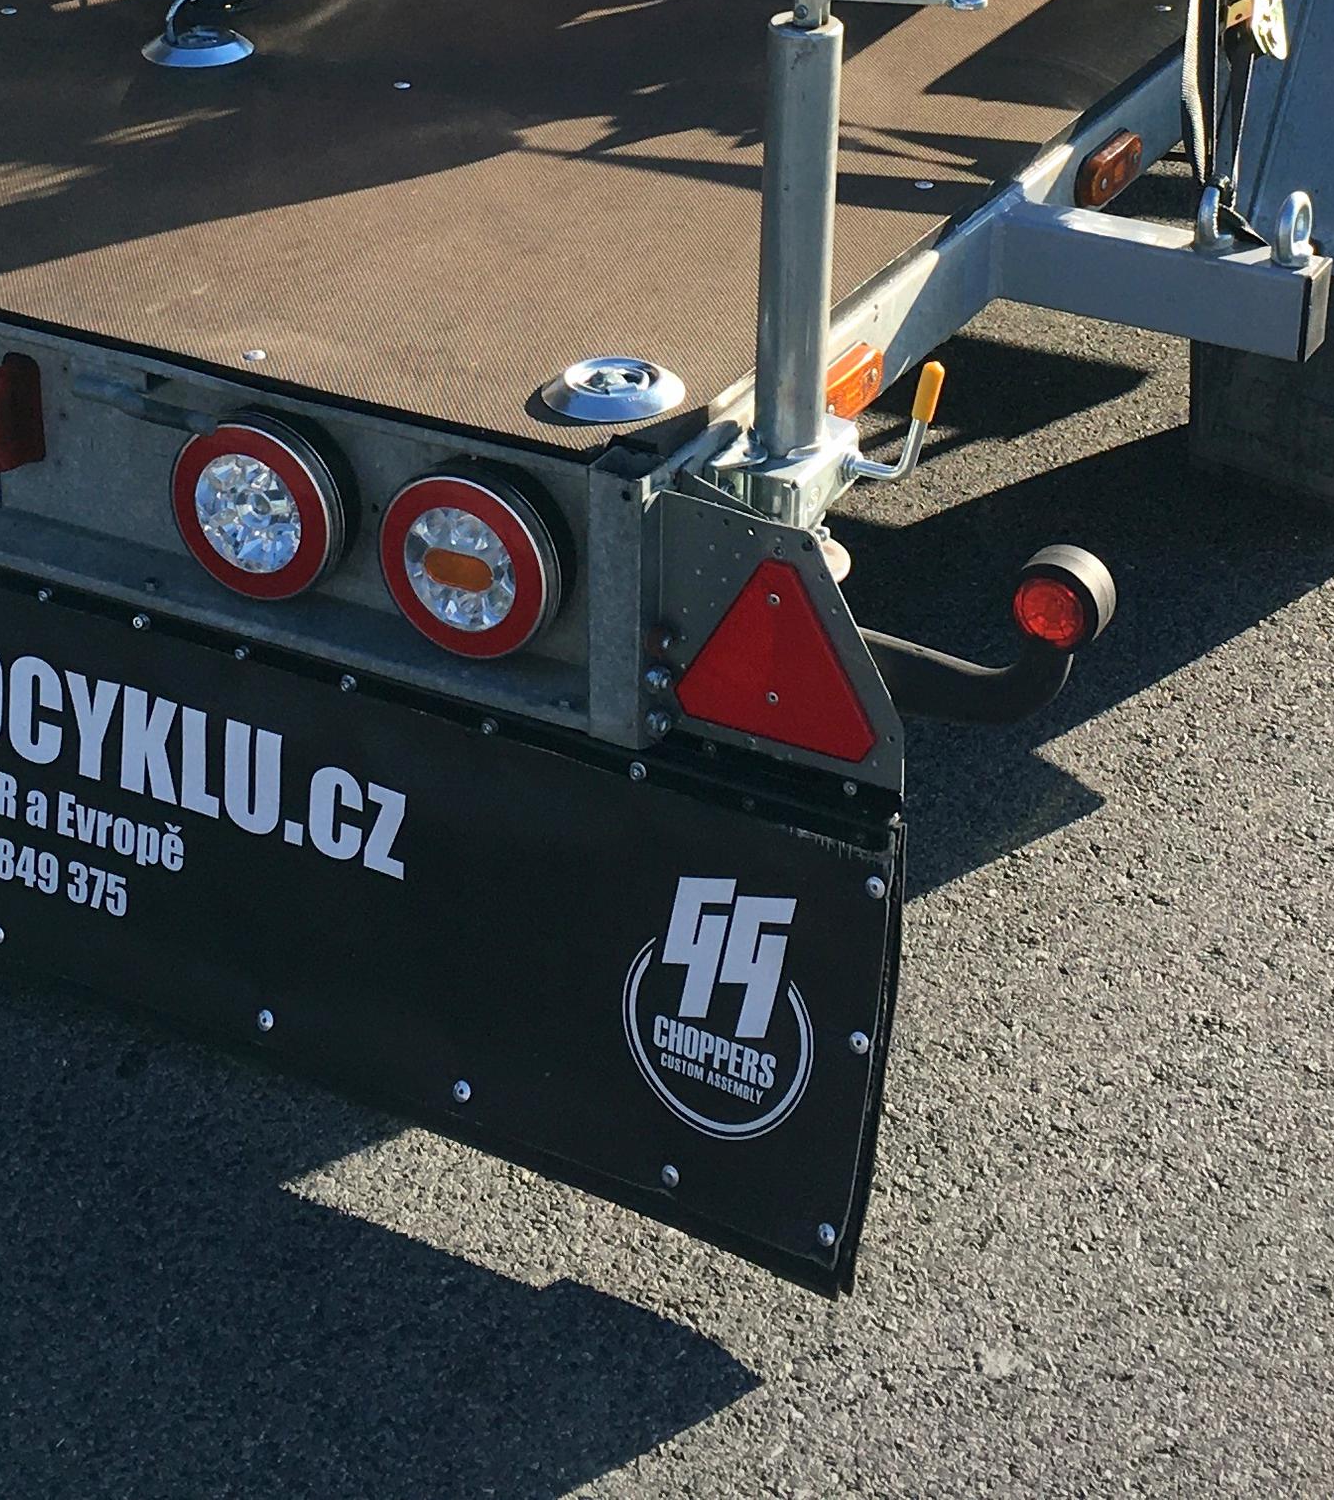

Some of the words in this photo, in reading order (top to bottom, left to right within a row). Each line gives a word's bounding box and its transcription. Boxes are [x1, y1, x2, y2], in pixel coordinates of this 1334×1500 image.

[25, 788, 48, 830] a
[57, 790, 185, 872] Evropě
[67, 861, 128, 917] 375
[653, 1014, 777, 1089] CHOPPERS
[660, 1052, 704, 1081] CUSTOM
[706, 1073, 764, 1105] ASSEMBLY
